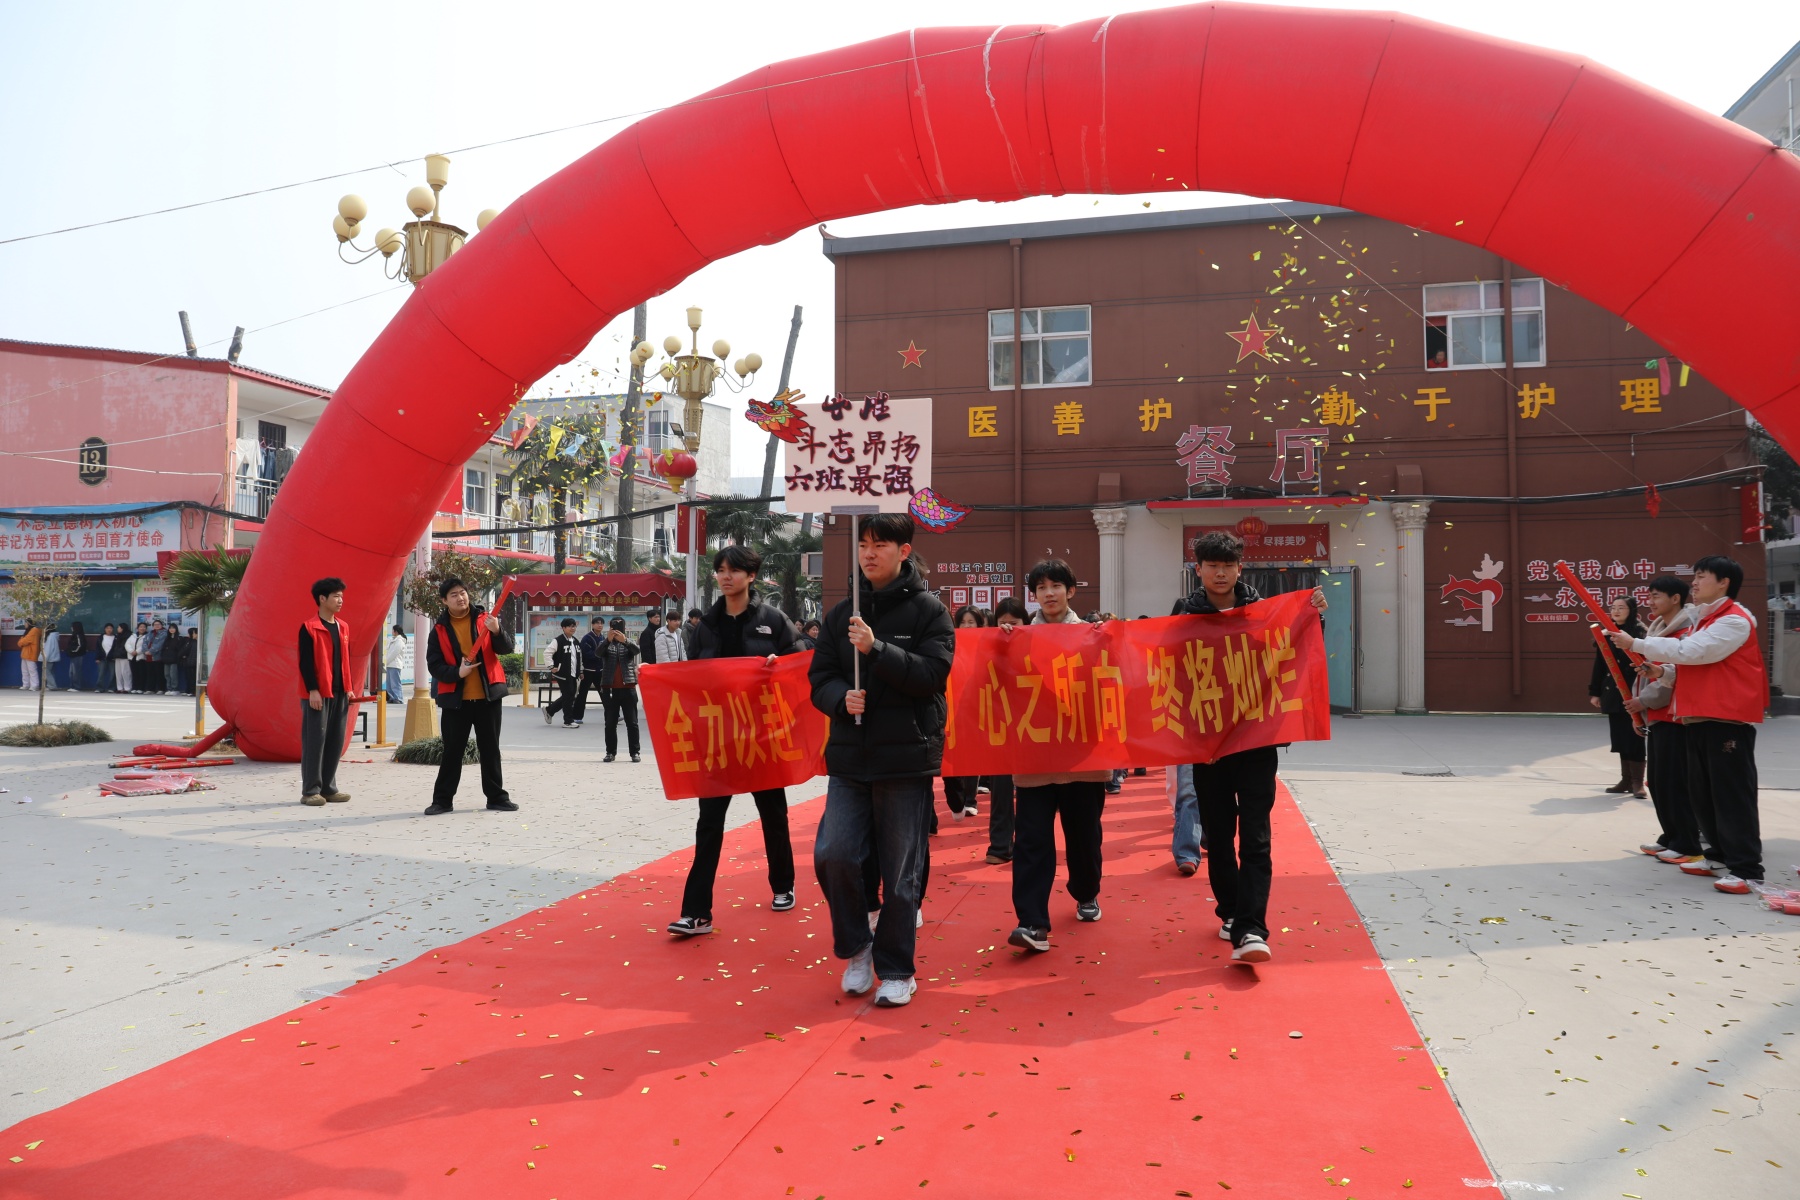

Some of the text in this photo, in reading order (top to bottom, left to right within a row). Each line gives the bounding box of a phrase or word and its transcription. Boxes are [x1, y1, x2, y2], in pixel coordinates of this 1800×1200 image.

[797, 425, 921, 466] 斗志昂扬
[1175, 424, 1330, 487] 餐厅
[80, 449, 101, 474] 13
[784, 464, 915, 497] 六班最强
[82, 529, 165, 549] 为国育才使命
[1263, 535, 1306, 547] 尽释美妙
[937, 562, 1007, 573] 强化五个引领
[664, 681, 804, 774] 全力以赴
[978, 649, 1128, 748] 心之所向
[1146, 625, 1304, 740] 终将灿烂
